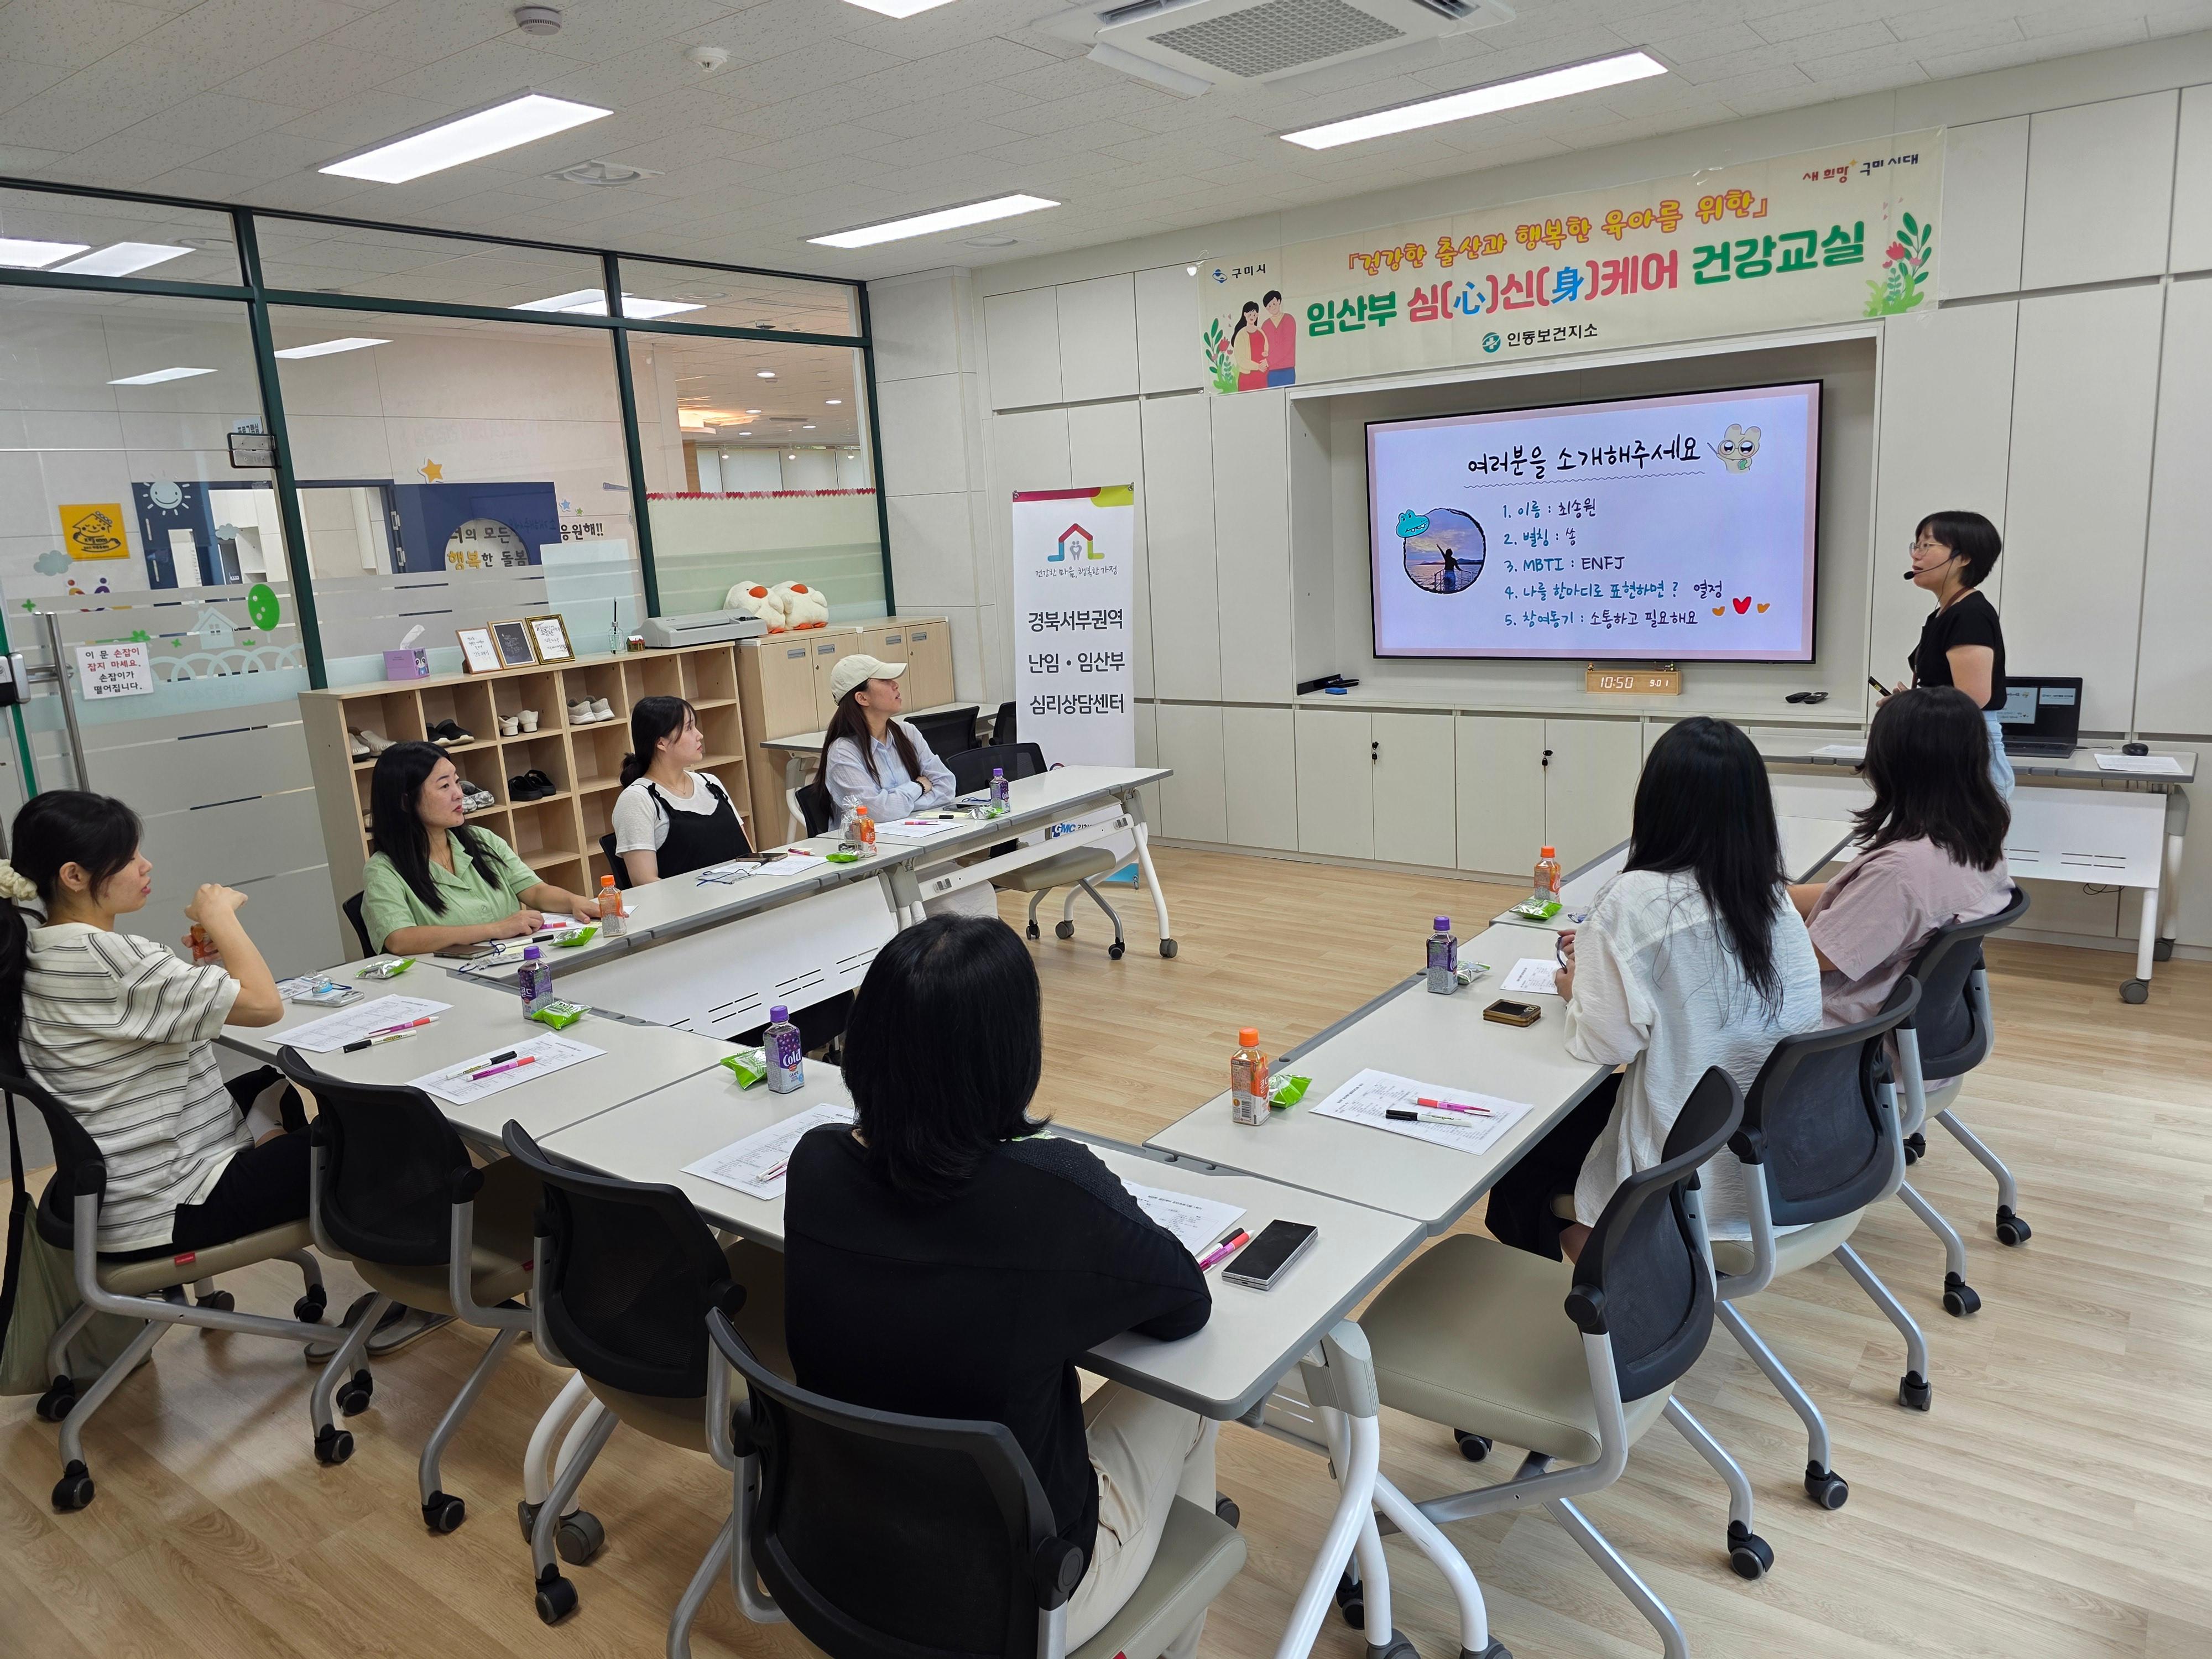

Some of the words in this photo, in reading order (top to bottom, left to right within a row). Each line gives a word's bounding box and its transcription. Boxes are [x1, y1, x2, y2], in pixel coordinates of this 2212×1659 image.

[1436, 233, 1507, 267] 출산과
[1516, 217, 1590, 252] 행복한
[1602, 200, 1683, 240] 육아를
[1232, 263, 1266, 279] 구미시
[1307, 291, 1397, 337] 임산부
[1692, 221, 1865, 285] 건강교실
[1507, 322, 1598, 347] 인동보건지소
[1468, 445, 1547, 479] 여러분을
[1557, 433, 1701, 469] 소개해주세요
[1503, 504, 1512, 519] 1.
[1518, 502, 1541, 519] 이름
[1558, 498, 1597, 518] 최송원
[484, 526, 511, 544] 모든
[560, 523, 603, 541] 응원해!!
[1504, 533, 1517, 546] 2.
[1523, 529, 1549, 547] 별칭
[447, 550, 493, 570] 행복한
[501, 550, 528, 567] 돌봄
[1504, 560, 1517, 573] 3.
[1523, 558, 1565, 572] MBTI
[1582, 556, 1625, 571] ENFJ
[1036, 568, 1057, 578] 건강한
[1059, 566, 1078, 578] 마음,
[1078, 565, 1099, 577] 행복한
[1100, 565, 1118, 575] 가정
[1505, 586, 1517, 599] 4.
[1523, 582, 1547, 600] 나를
[1554, 581, 1604, 600] 한마디로
[1610, 580, 1665, 600] 표현하면
[1693, 580, 1723, 600] 열정
[1028, 608, 1124, 633] 경북서부권역
[1505, 613, 1517, 627] 5.
[1590, 609, 1638, 629] 소통하고
[1645, 609, 1698, 627] 필요해요
[86, 651, 94, 659] 이
[100, 650, 109, 659] 문
[113, 647, 139, 658] 손잡이
[1028, 653, 1060, 674] 난임
[1078, 651, 1125, 673] 임산부
[87, 662, 106, 672] 잡지
[111, 659, 141, 668] 마세요.
[99, 671, 134, 682] 손잡이가
[1600, 676, 1634, 689] 10:50
[93, 682, 143, 695] 떨어집니다.
[1029, 693, 1125, 716] 심리상담센터
[1053, 823, 1076, 833] GMC
[782, 1048, 801, 1067] Cold
